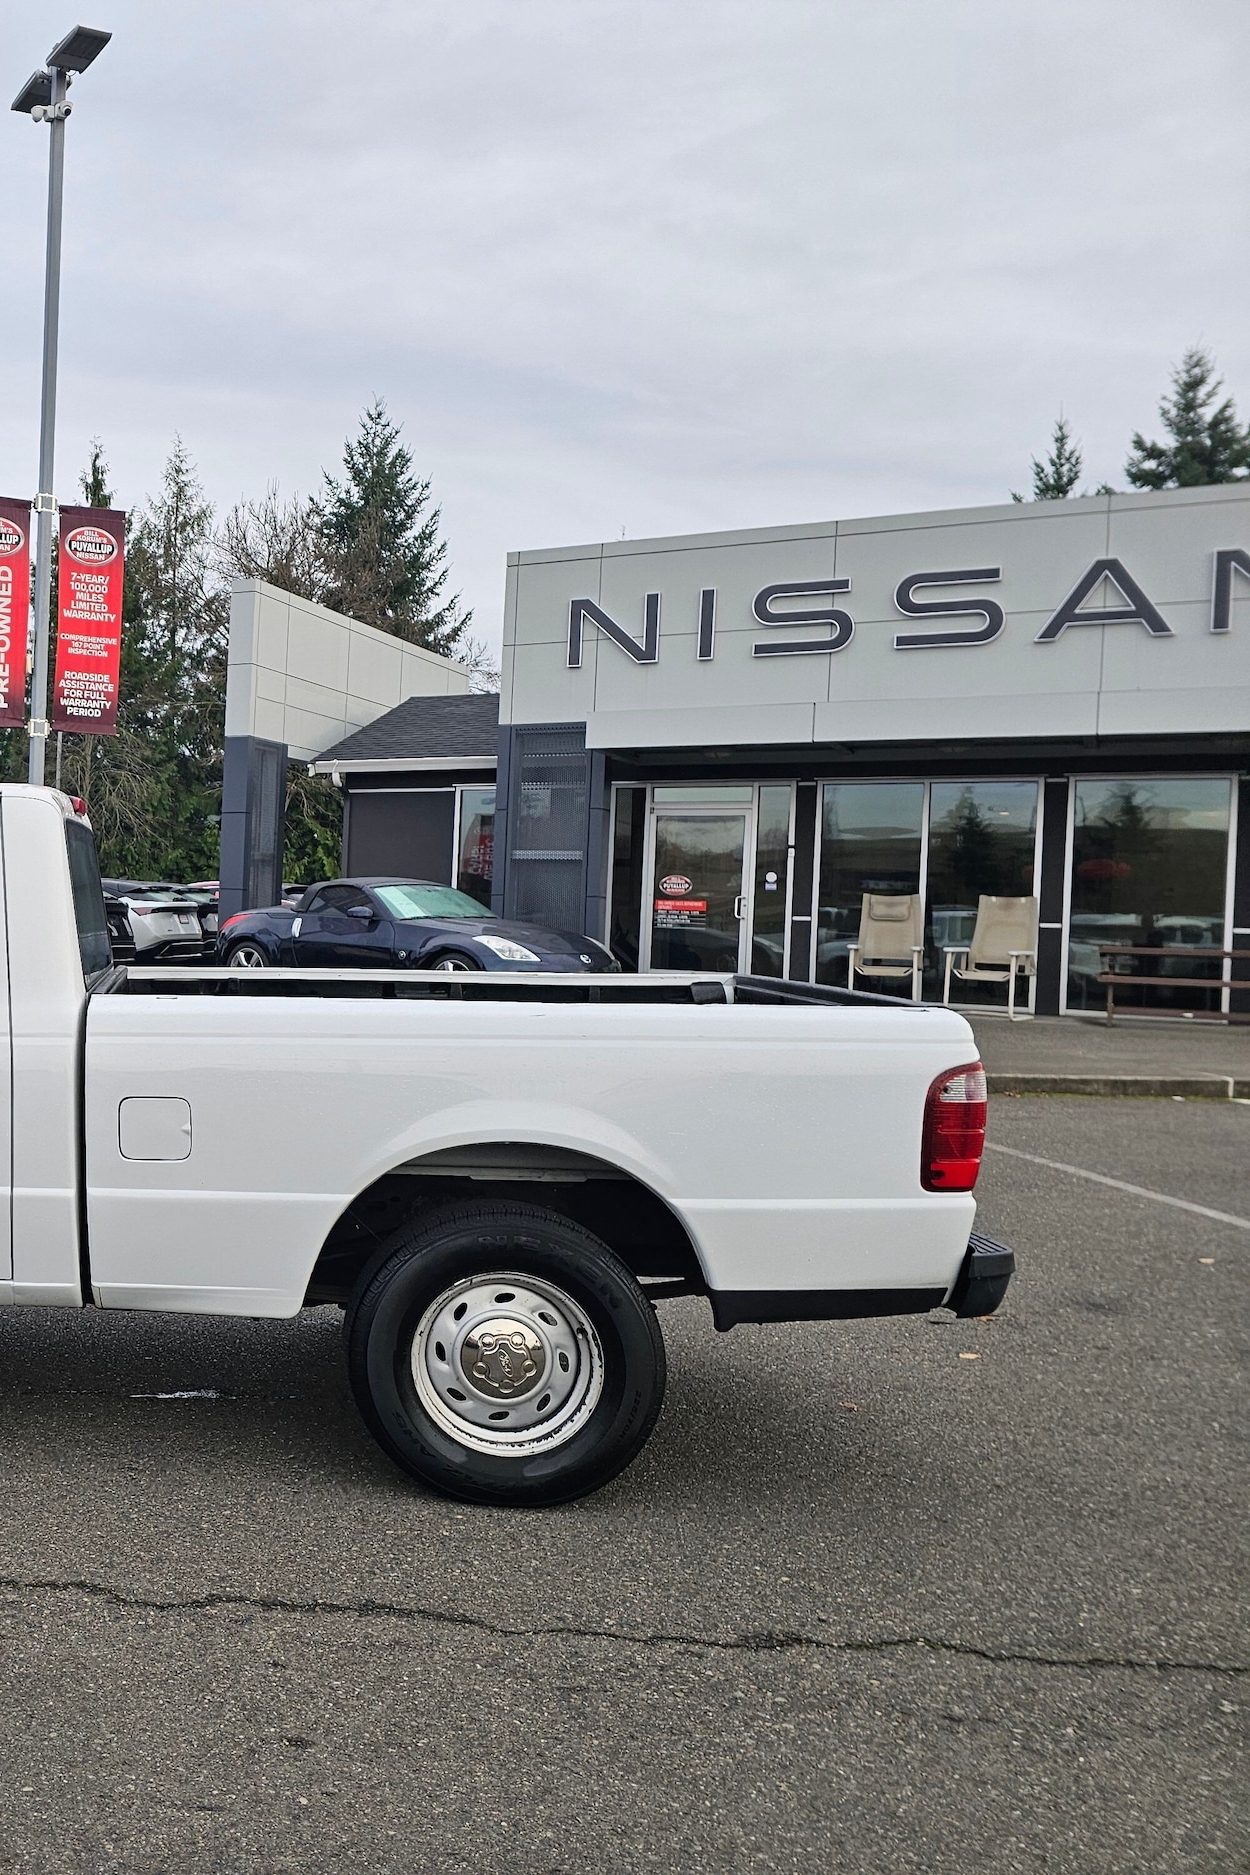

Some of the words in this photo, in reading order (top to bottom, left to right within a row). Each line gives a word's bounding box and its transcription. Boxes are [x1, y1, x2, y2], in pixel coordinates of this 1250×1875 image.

[76, 534, 107, 543] KORUM'S
[71, 541, 113, 555] PUYALLUP
[76, 552, 106, 561] NISSAN
[71, 572, 109, 584] 7-YEAR/
[70, 582, 108, 593] 100,000
[76, 592, 104, 602] MILES
[71, 601, 108, 612] LIMITED
[63, 609, 116, 622] WARRANTY
[60, 633, 117, 645] COMPREHENSIVE
[83, 642, 105, 650] POINT
[68, 647, 108, 657] INSPECTION
[64, 671, 110, 683] ROADSIDE
[59, 680, 114, 692] ASSISTANCE
[64, 689, 83, 698] FOR
[84, 690, 106, 700] FULL
[60, 698, 111, 709] WARRANTY
[67, 707, 101, 717] PERIOD
